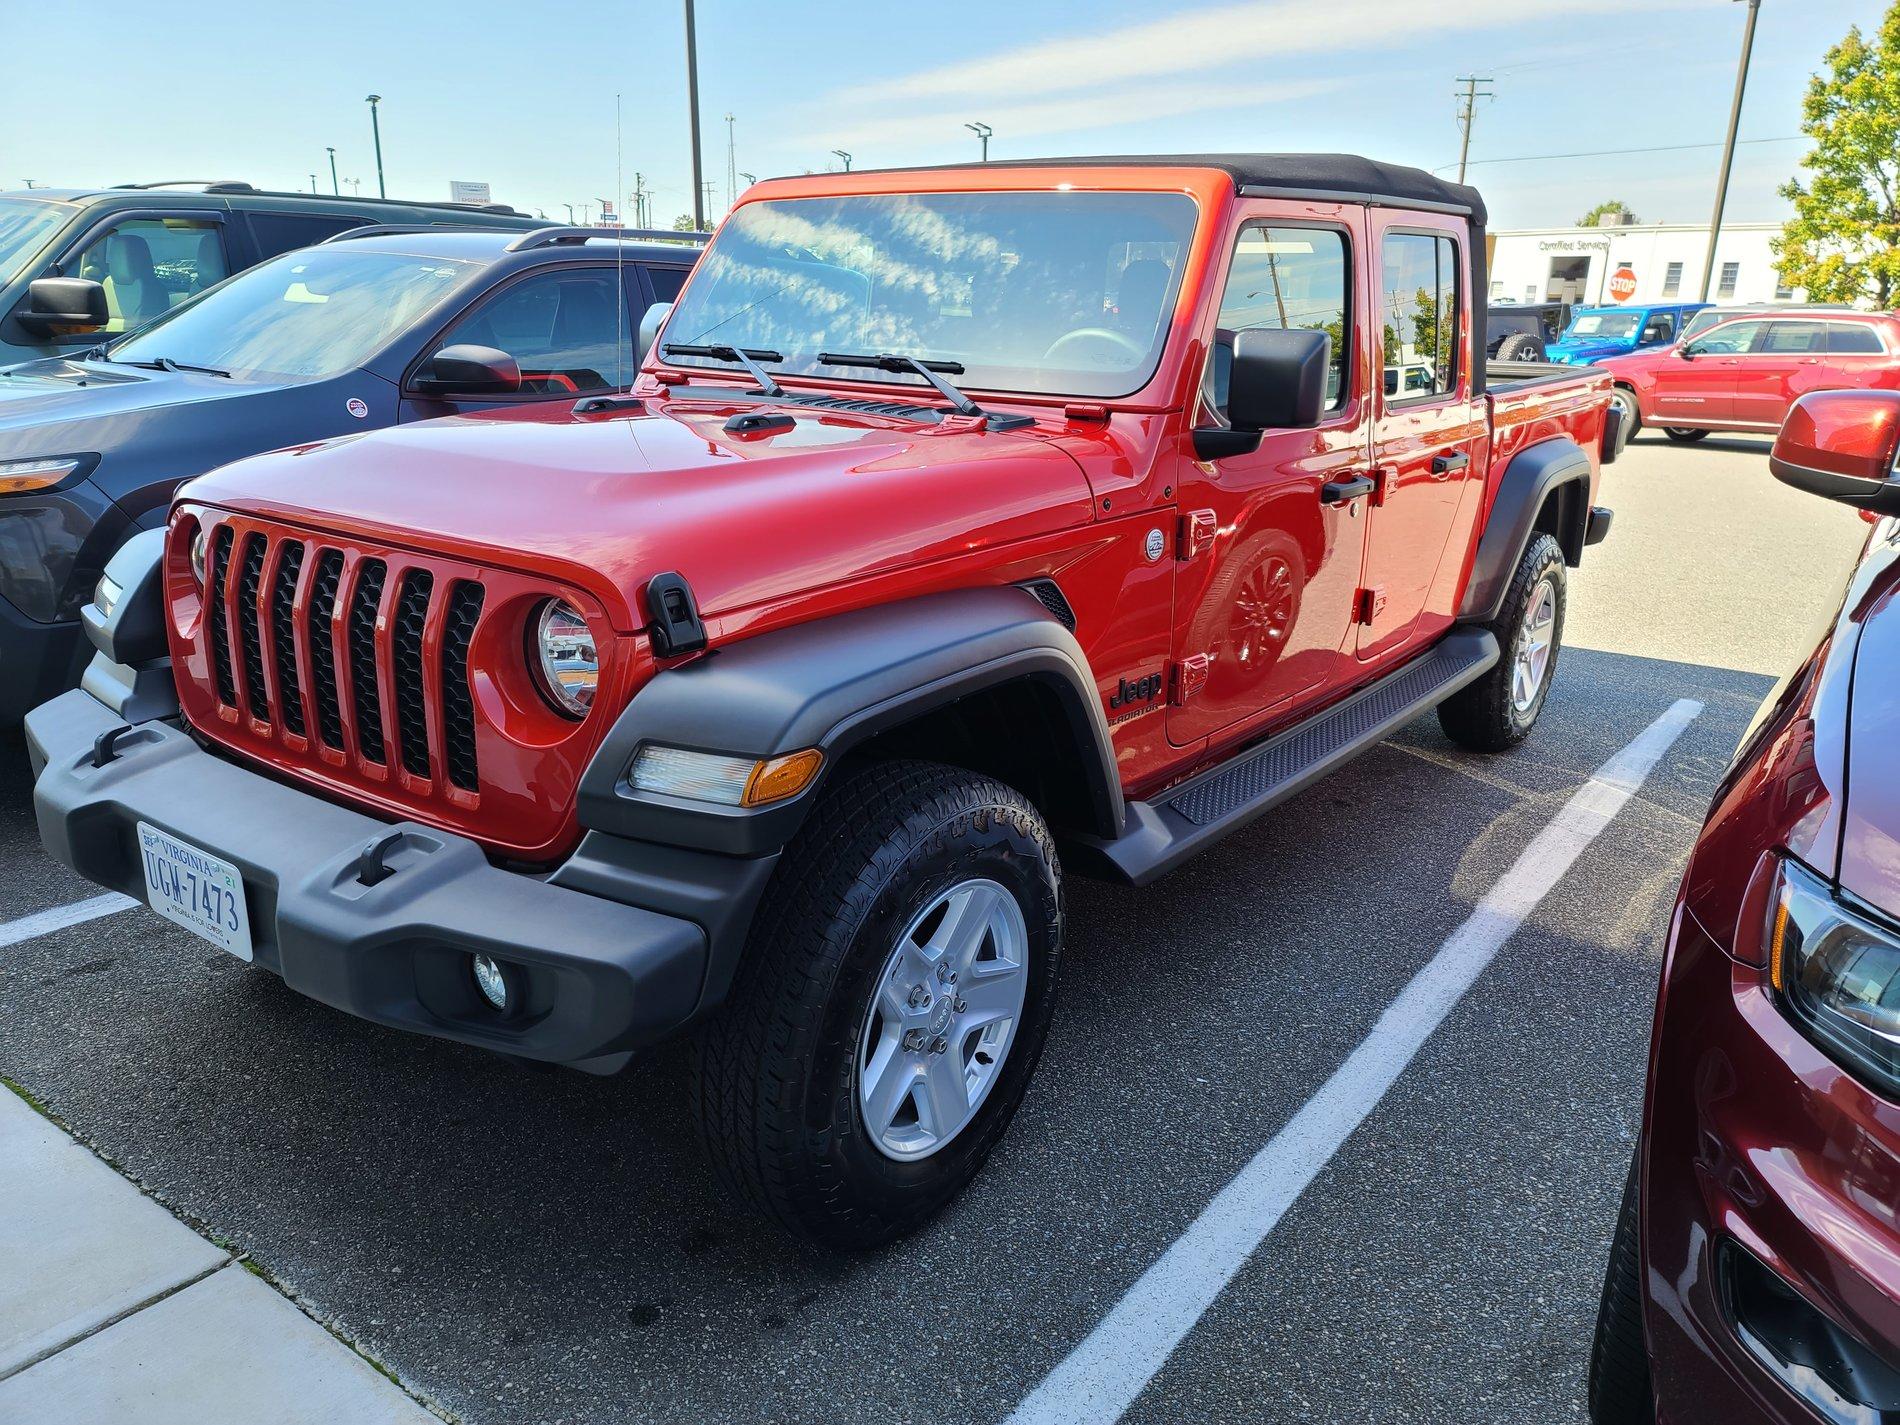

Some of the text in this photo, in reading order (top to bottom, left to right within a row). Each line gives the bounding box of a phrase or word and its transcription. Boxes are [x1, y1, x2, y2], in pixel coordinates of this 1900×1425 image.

[1610, 277, 1636, 292] STOP
[1110, 673, 1162, 709] Jeep
[161, 839, 213, 878] VIRGINIA
[225, 875, 235, 889] 21
